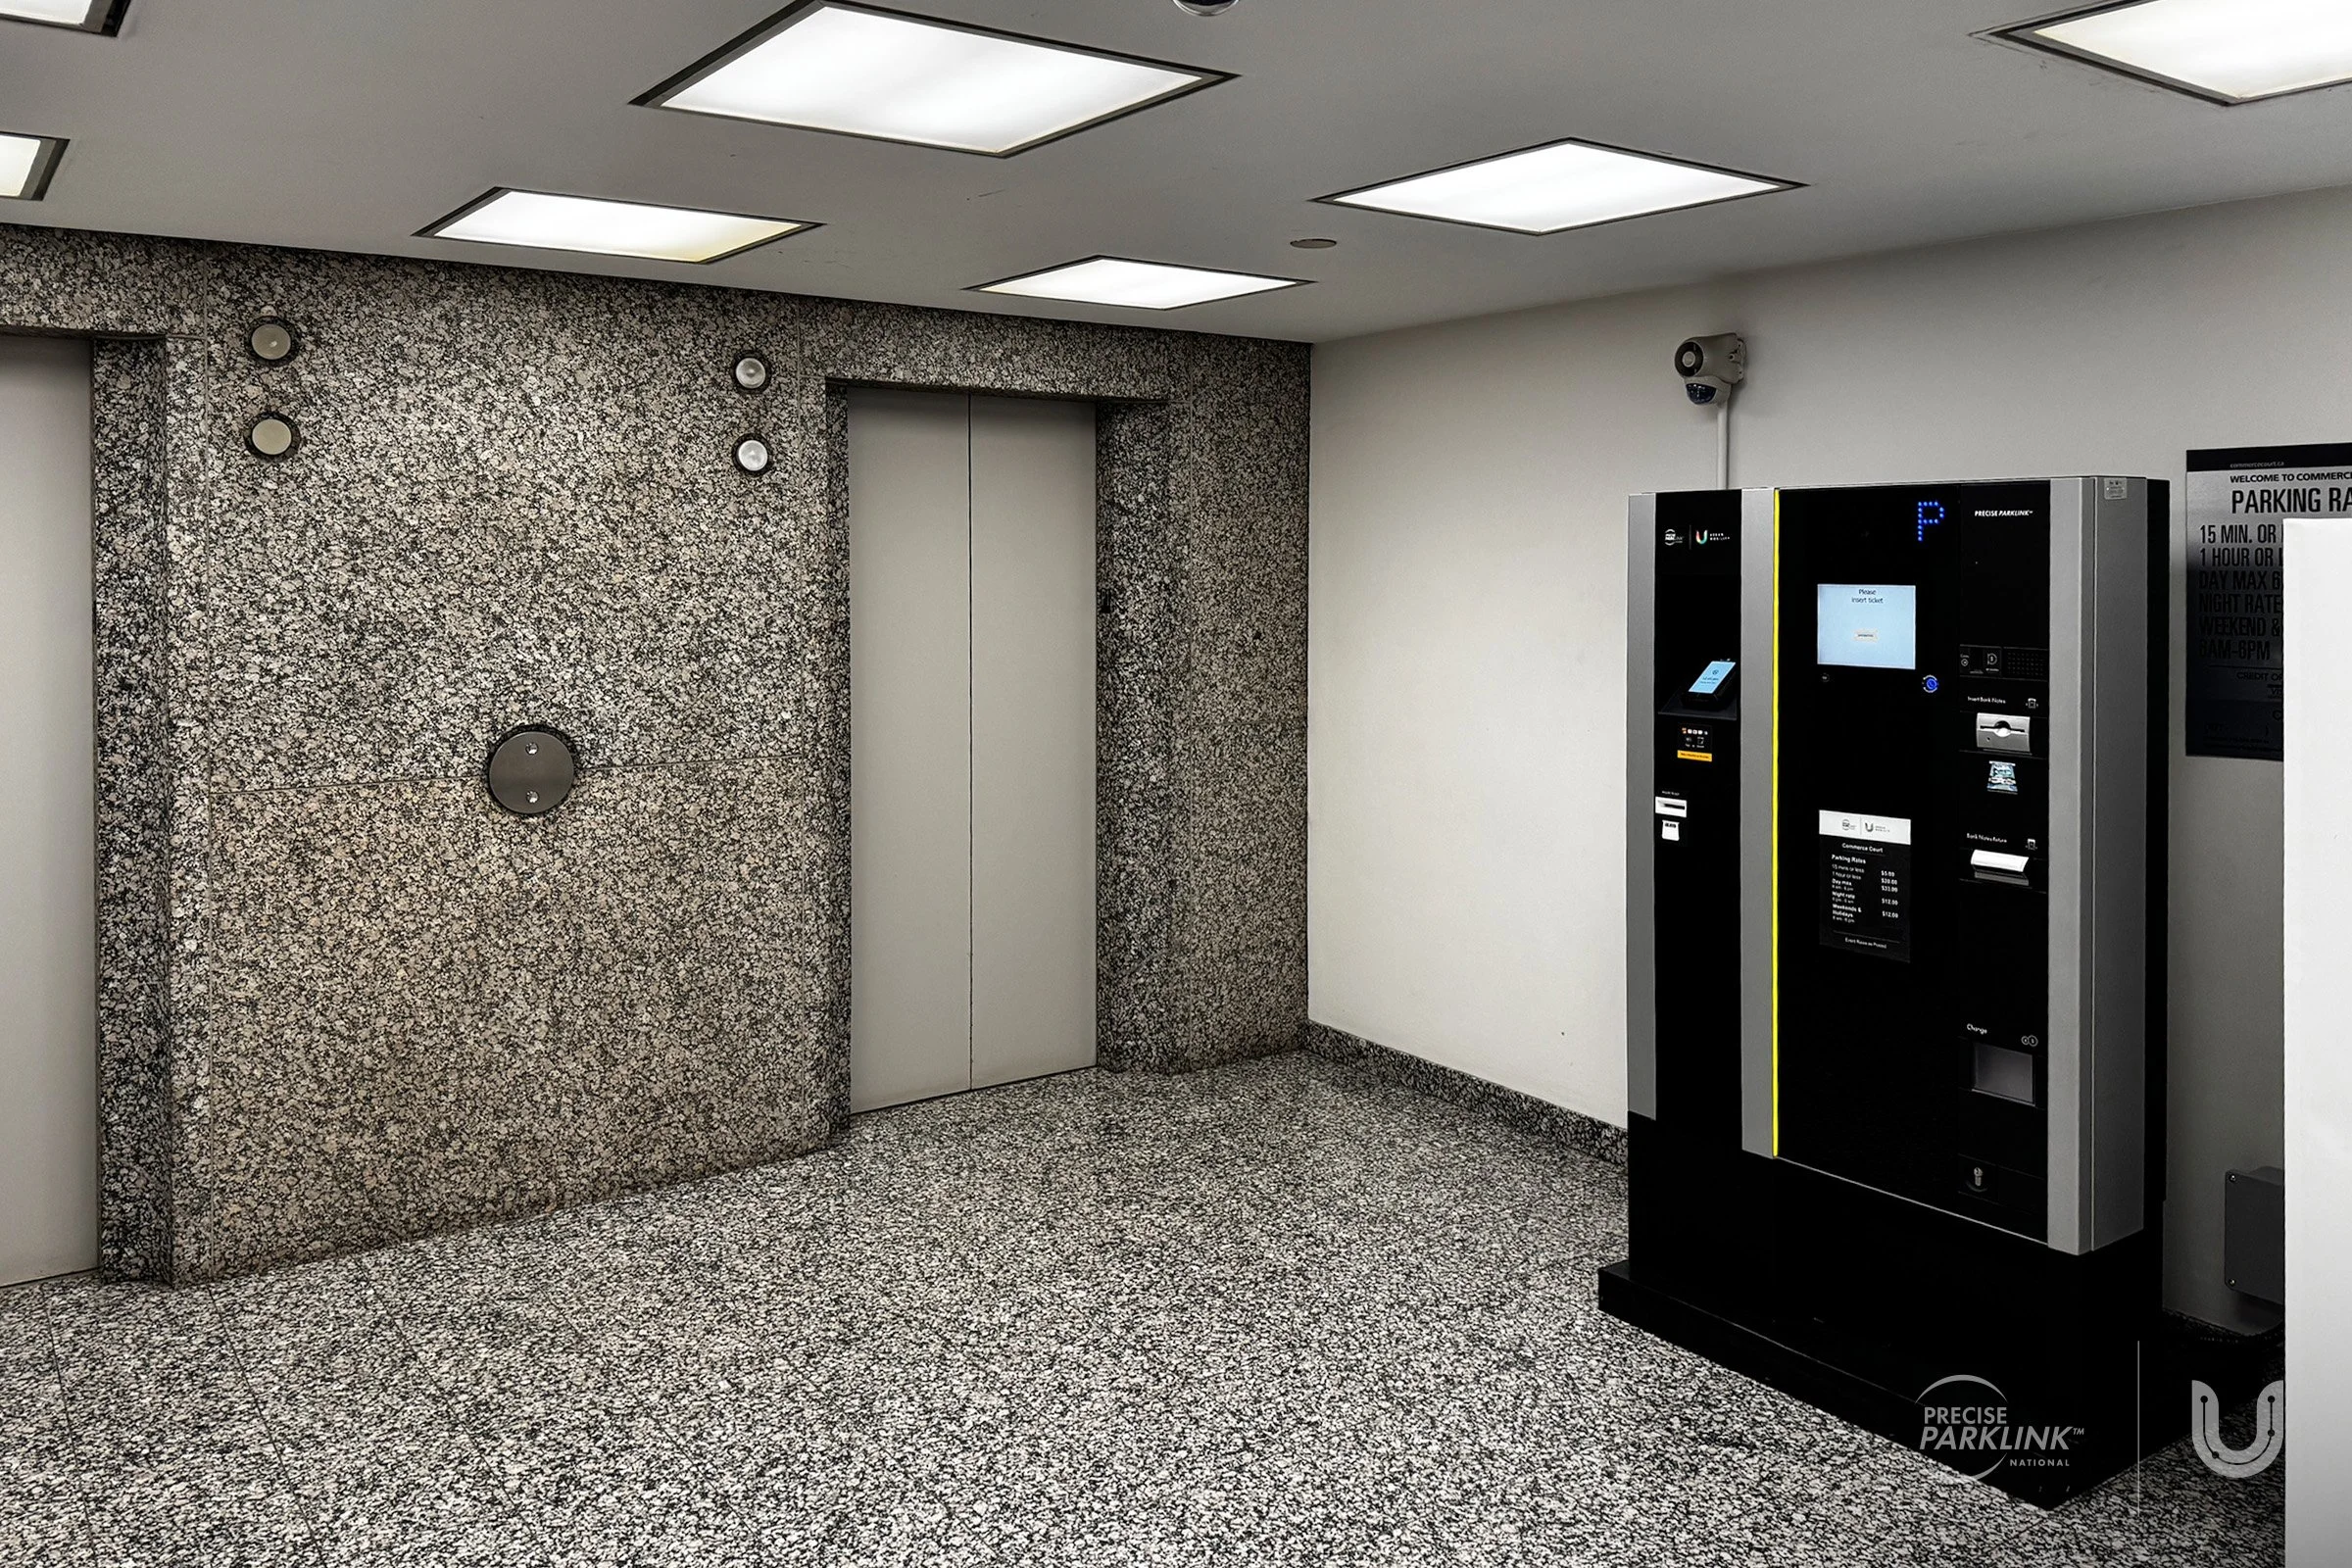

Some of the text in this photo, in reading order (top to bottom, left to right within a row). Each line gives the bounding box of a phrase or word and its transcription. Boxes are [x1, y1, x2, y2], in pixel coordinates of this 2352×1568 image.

[2230, 474, 2279, 483] WELCOME
[2231, 487, 2321, 514] PARKING
[1918, 501, 1945, 542] P
[2200, 523, 2277, 544] 15 MIN. OR
[2200, 548, 2206, 566] 1
[2212, 548, 2250, 566] HOUR
[2255, 548, 2274, 566] OR
[2199, 570, 2229, 590] DAY
[2232, 570, 2268, 590] MAX
[2199, 593, 2281, 613] NIGHT RATE
[2199, 616, 2280, 637] WEEKEND &
[1831, 854, 1850, 862] Parking
[1966, 1023, 1987, 1035] Change
